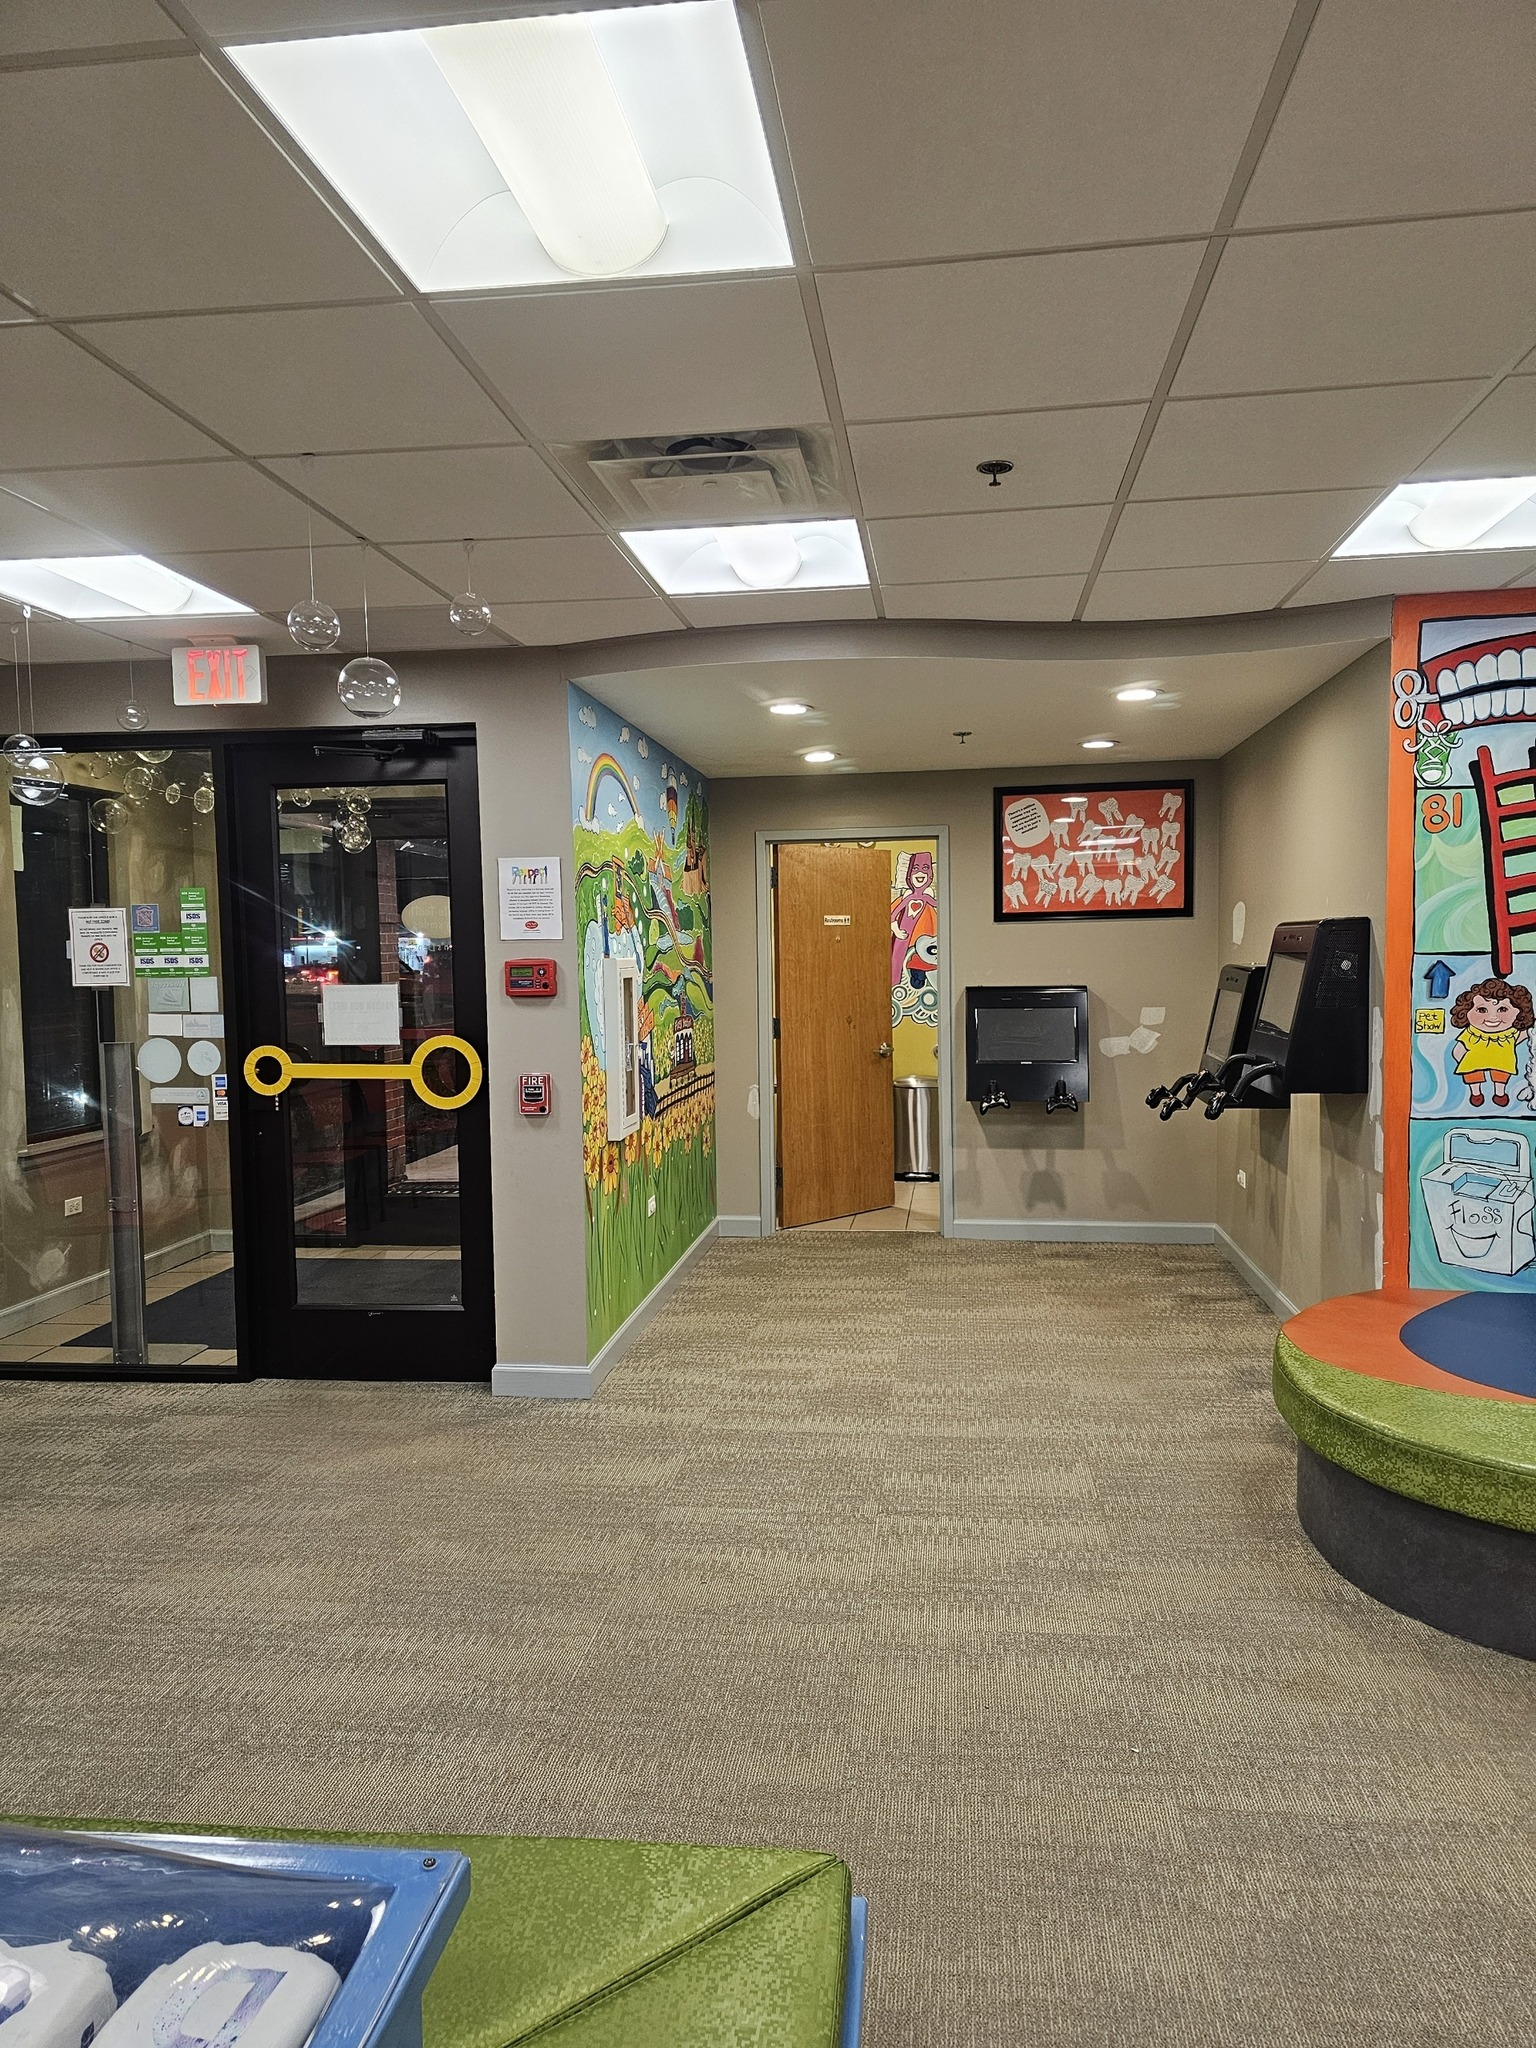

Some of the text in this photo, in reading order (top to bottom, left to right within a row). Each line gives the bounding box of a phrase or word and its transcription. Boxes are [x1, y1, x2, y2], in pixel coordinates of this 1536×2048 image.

[187, 648, 248, 701] EXIT
[1422, 792, 1463, 834] 81
[511, 865, 549, 879] Respect
[1419, 1012, 1438, 1021] Pet
[1416, 1020, 1442, 1031] Show
[522, 1076, 544, 1085] FIRE
